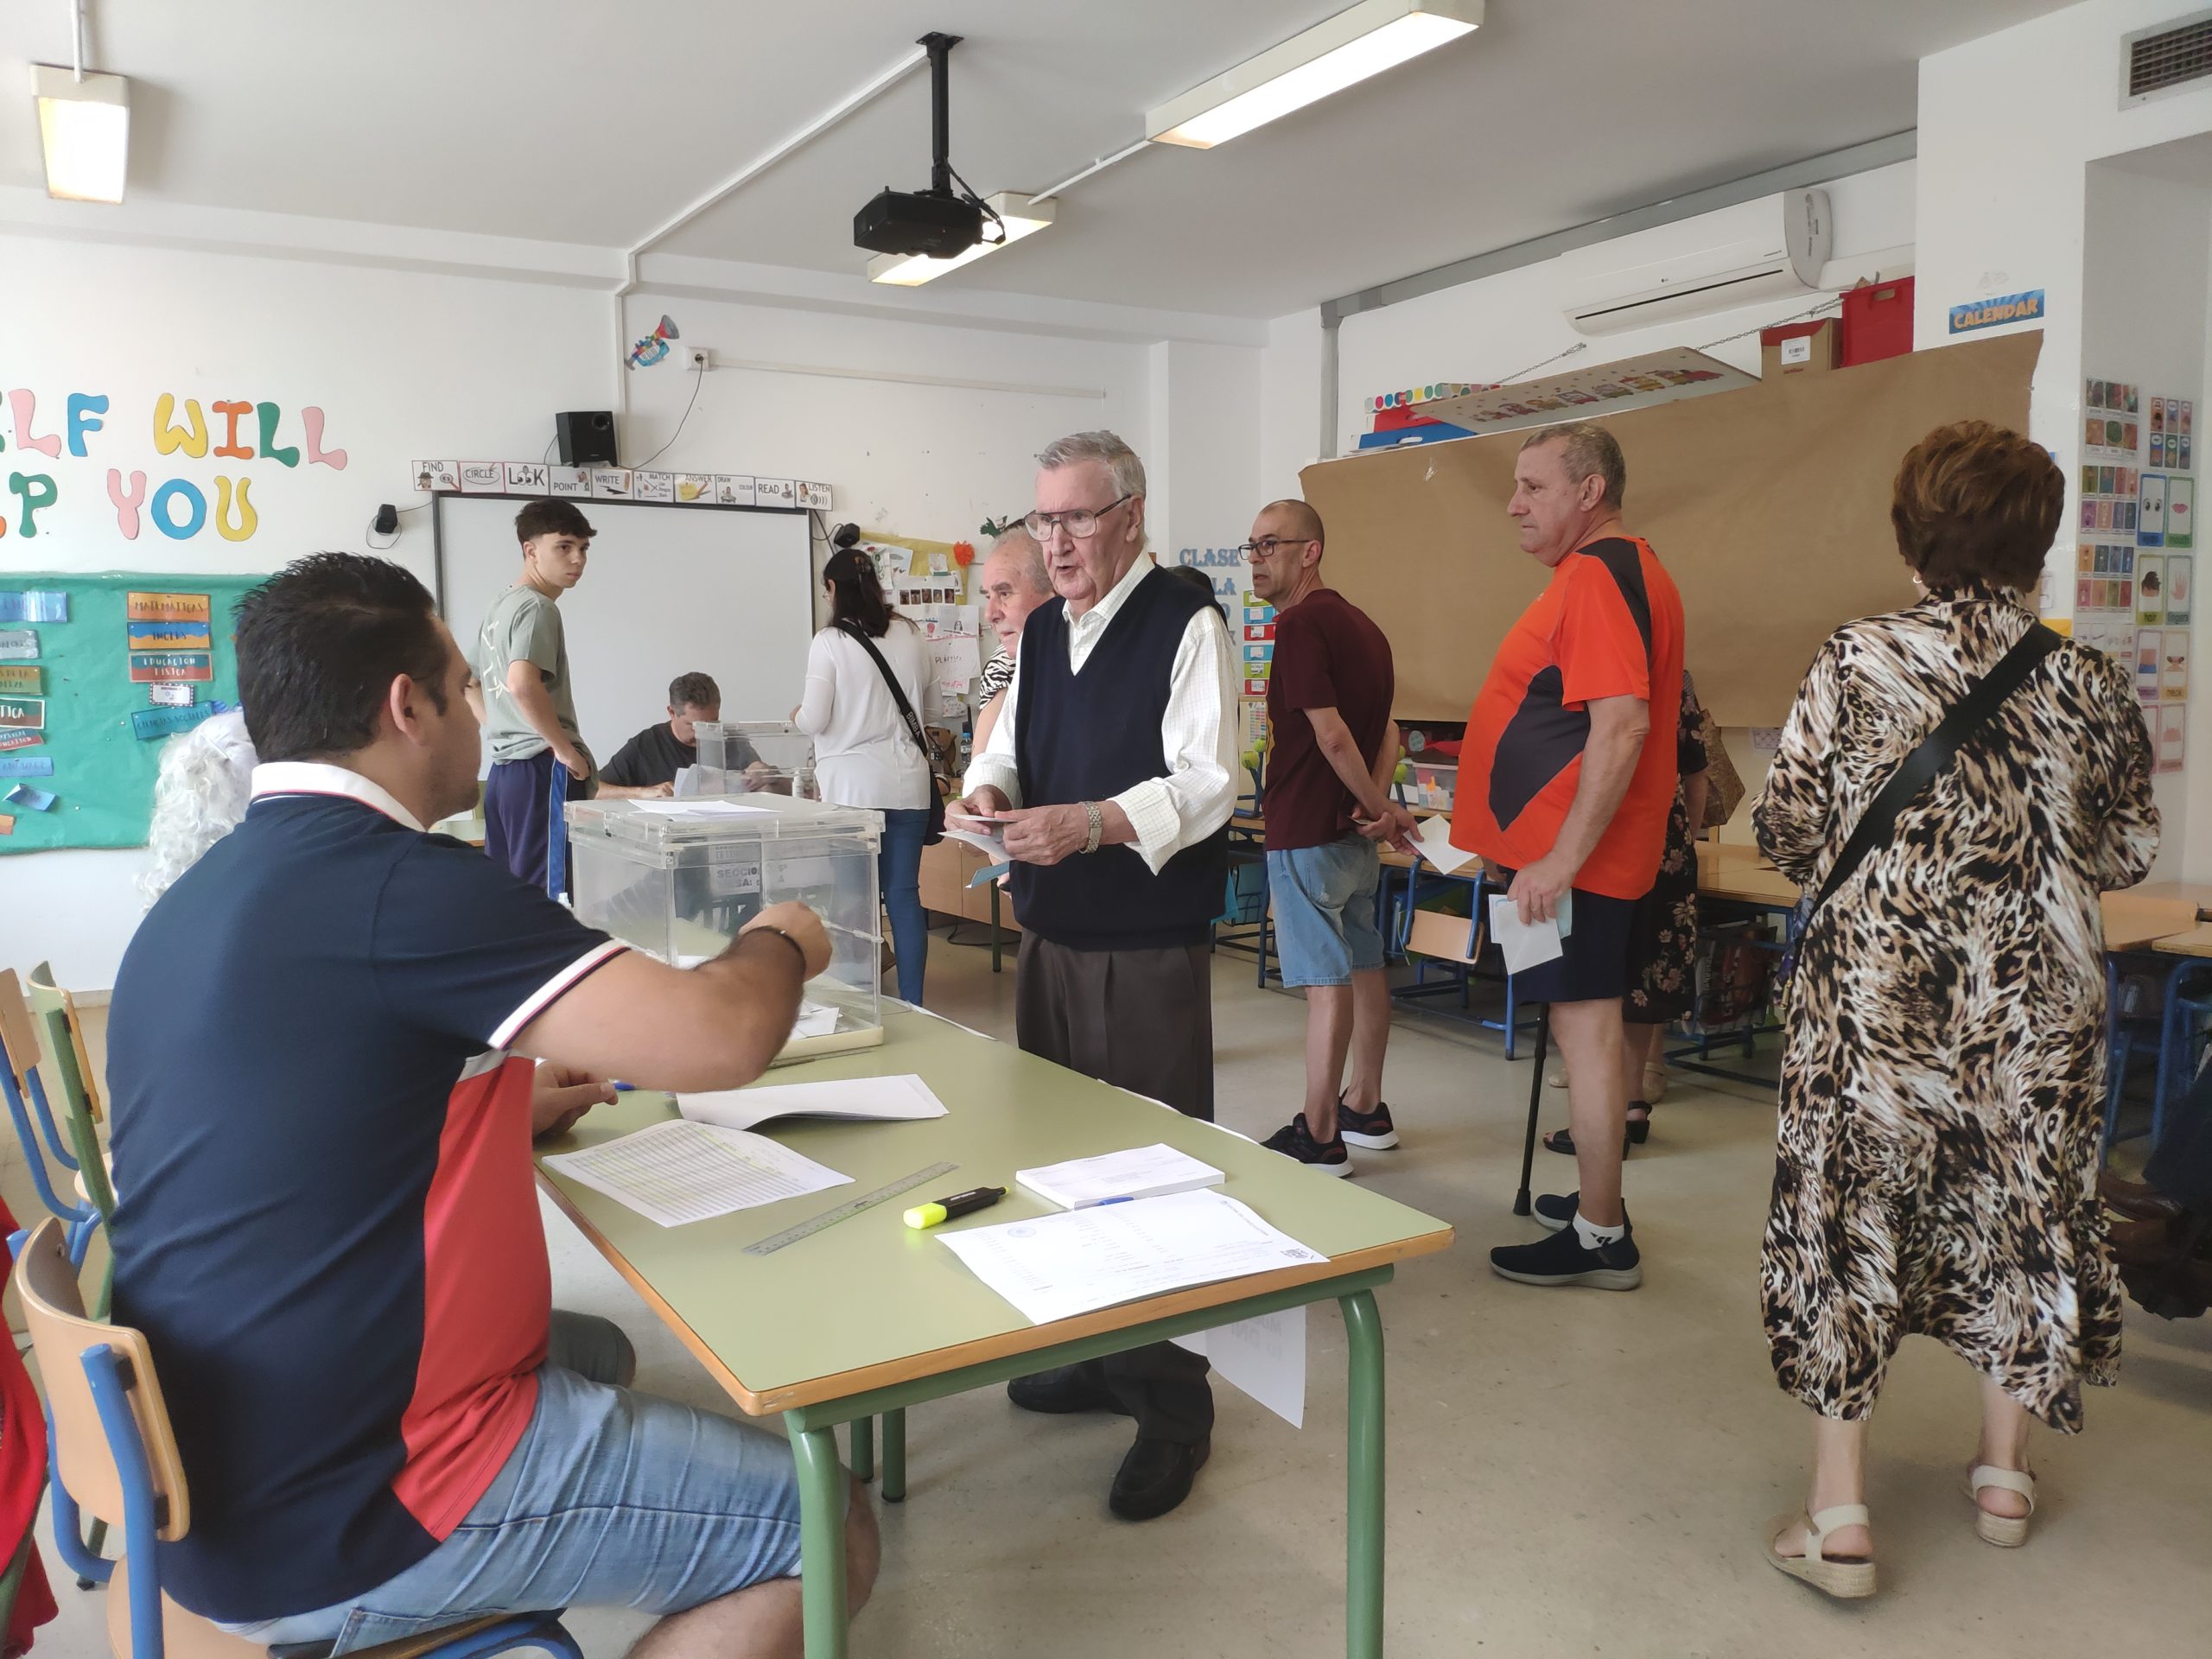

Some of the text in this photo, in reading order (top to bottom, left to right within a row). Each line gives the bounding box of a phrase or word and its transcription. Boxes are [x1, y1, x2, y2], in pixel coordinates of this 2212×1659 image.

[1954, 297, 2038, 329] CALENDAR
[0, 389, 348, 471] LF WILL
[423, 461, 444, 473] FIND
[465, 469, 494, 479] CIRCLE
[594, 474, 620, 485] WRITE
[649, 473, 671, 481] MATCH
[685, 474, 712, 483] ANSWER
[553, 482, 578, 492] POINT
[758, 483, 779, 494] READ
[809, 482, 830, 493] LISTEN
[0, 467, 258, 543] P YOU
[1179, 548, 1242, 567] CLASE
[716, 866, 761, 879] SECCIO
